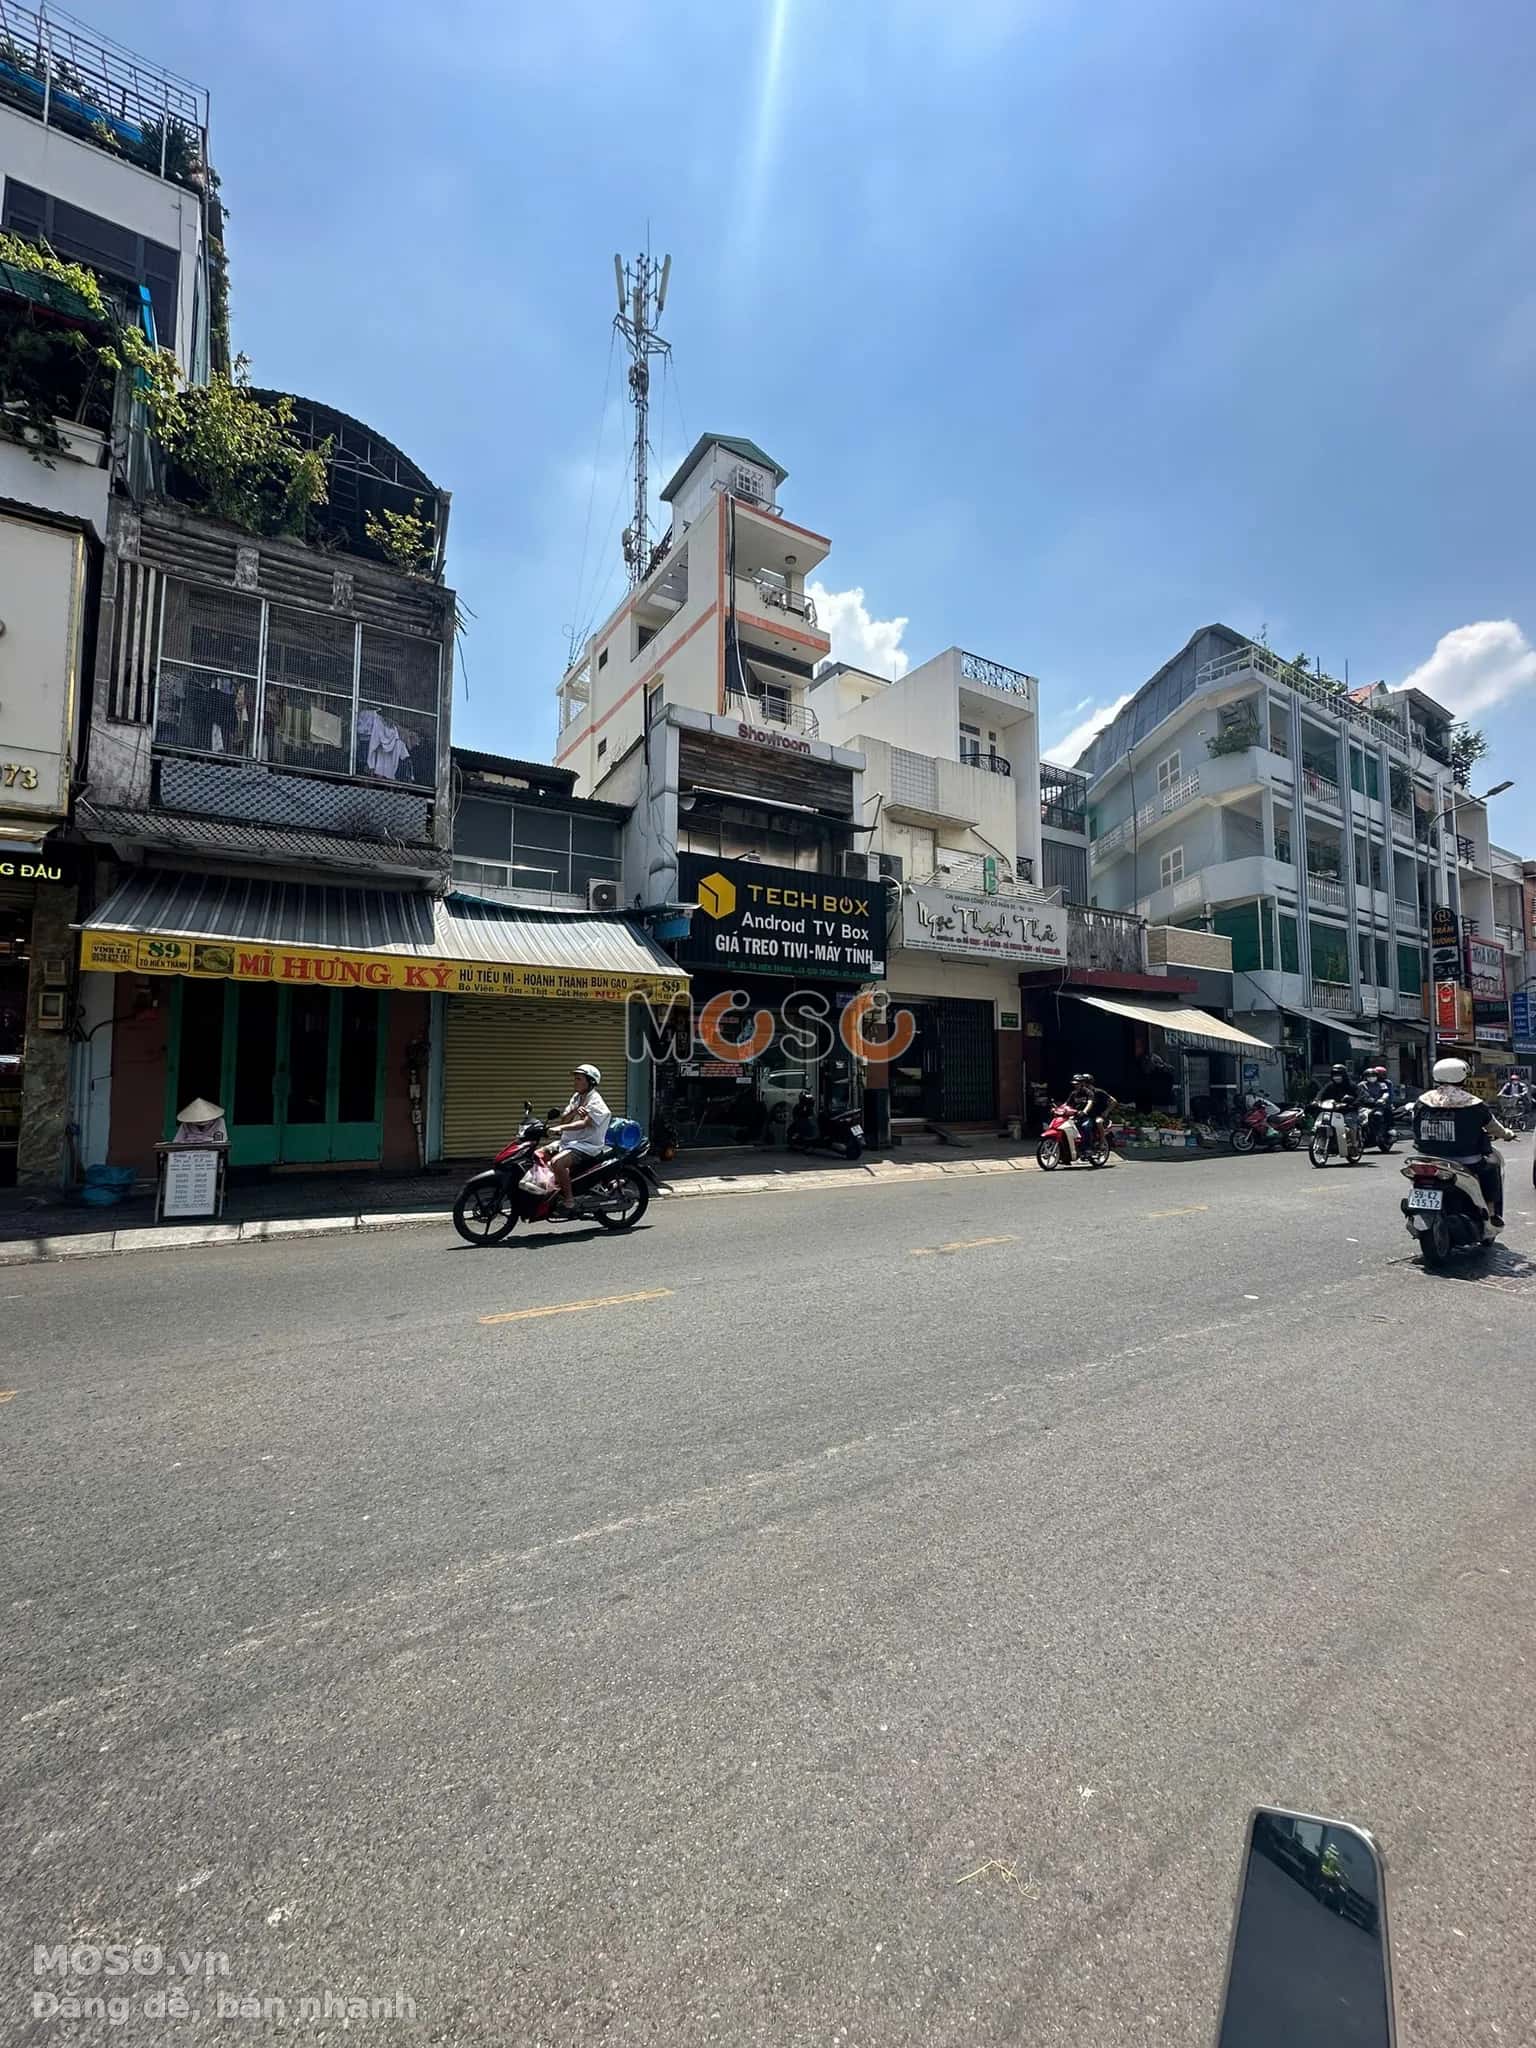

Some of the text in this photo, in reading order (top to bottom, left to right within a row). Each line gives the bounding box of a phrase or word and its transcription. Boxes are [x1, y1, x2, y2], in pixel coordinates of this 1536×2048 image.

[738, 723, 811, 754] Showroom
[0, 763, 38, 789] 73
[747, 884, 869, 917] TECH BOX
[741, 911, 870, 941] Android TV Box
[148, 942, 181, 958] 89
[715, 930, 740, 953] GIÁ
[742, 937, 778, 956] TREO
[845, 943, 874, 965] TÍNH
[239, 949, 453, 988] MÌ HƯNG KÝ
[662, 980, 681, 993] 89
